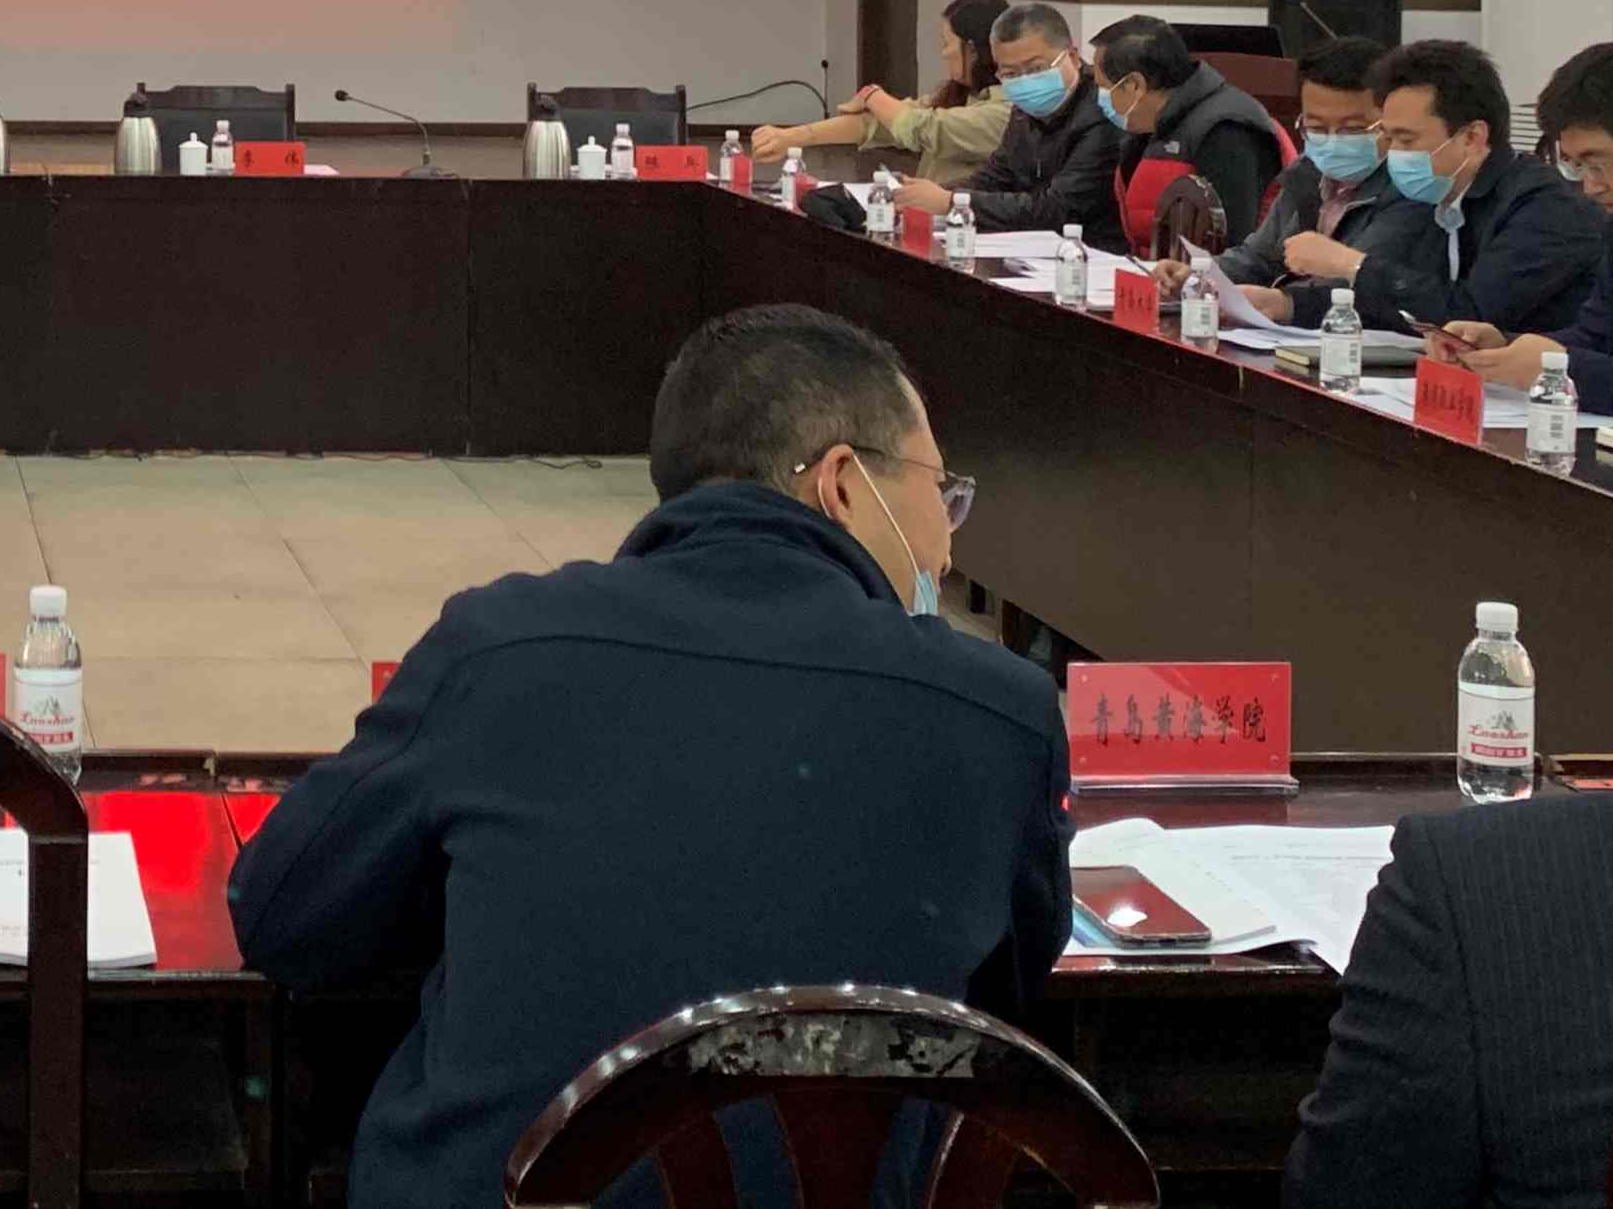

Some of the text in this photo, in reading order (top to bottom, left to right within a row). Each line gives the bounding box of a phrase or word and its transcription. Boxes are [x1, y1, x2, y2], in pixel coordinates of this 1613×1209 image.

[1090, 692, 1267, 747] 青岛黄海学院
